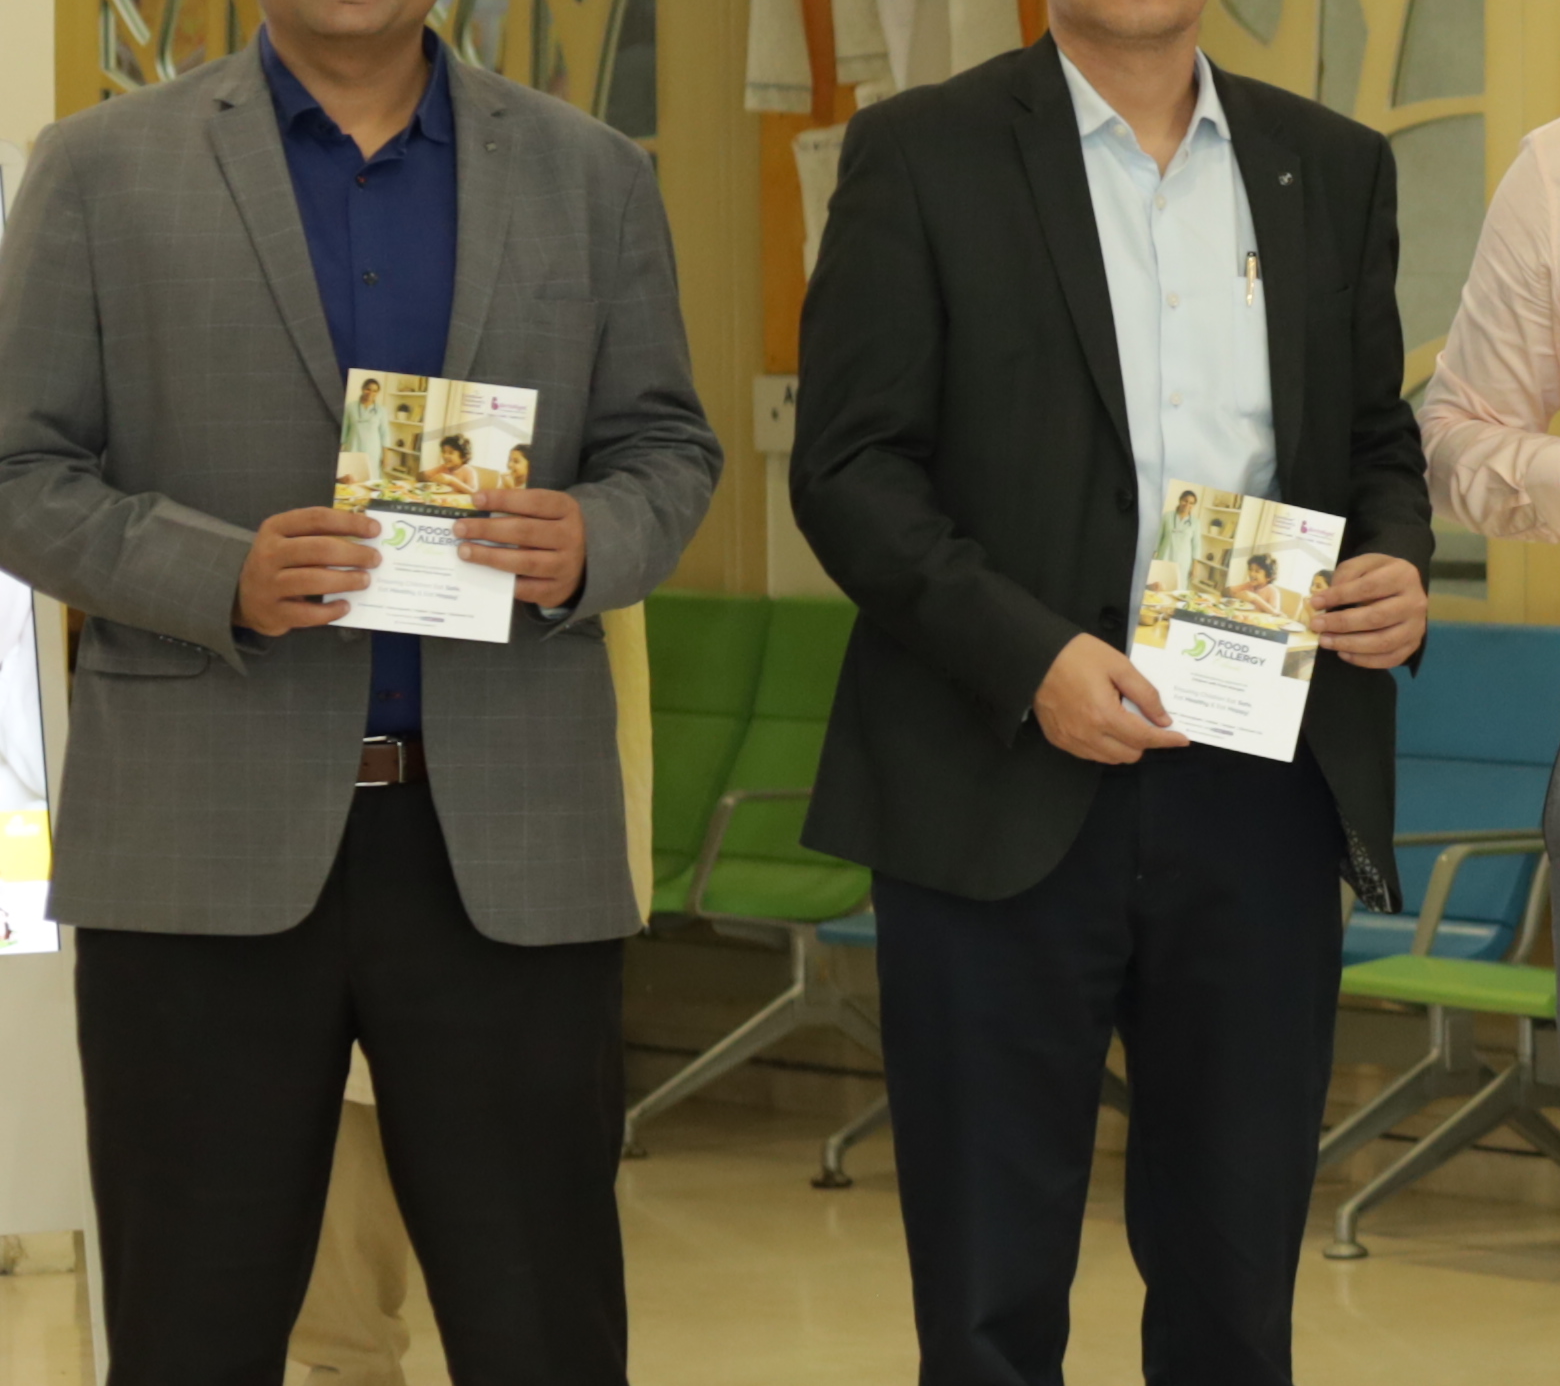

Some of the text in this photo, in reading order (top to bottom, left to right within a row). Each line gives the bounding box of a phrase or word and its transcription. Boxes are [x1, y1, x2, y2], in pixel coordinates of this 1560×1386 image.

[418, 524, 453, 537] FOOD
[416, 534, 463, 546] ALLERG
[1217, 638, 1250, 654] FOOD
[1215, 648, 1266, 667] ALLERGY
